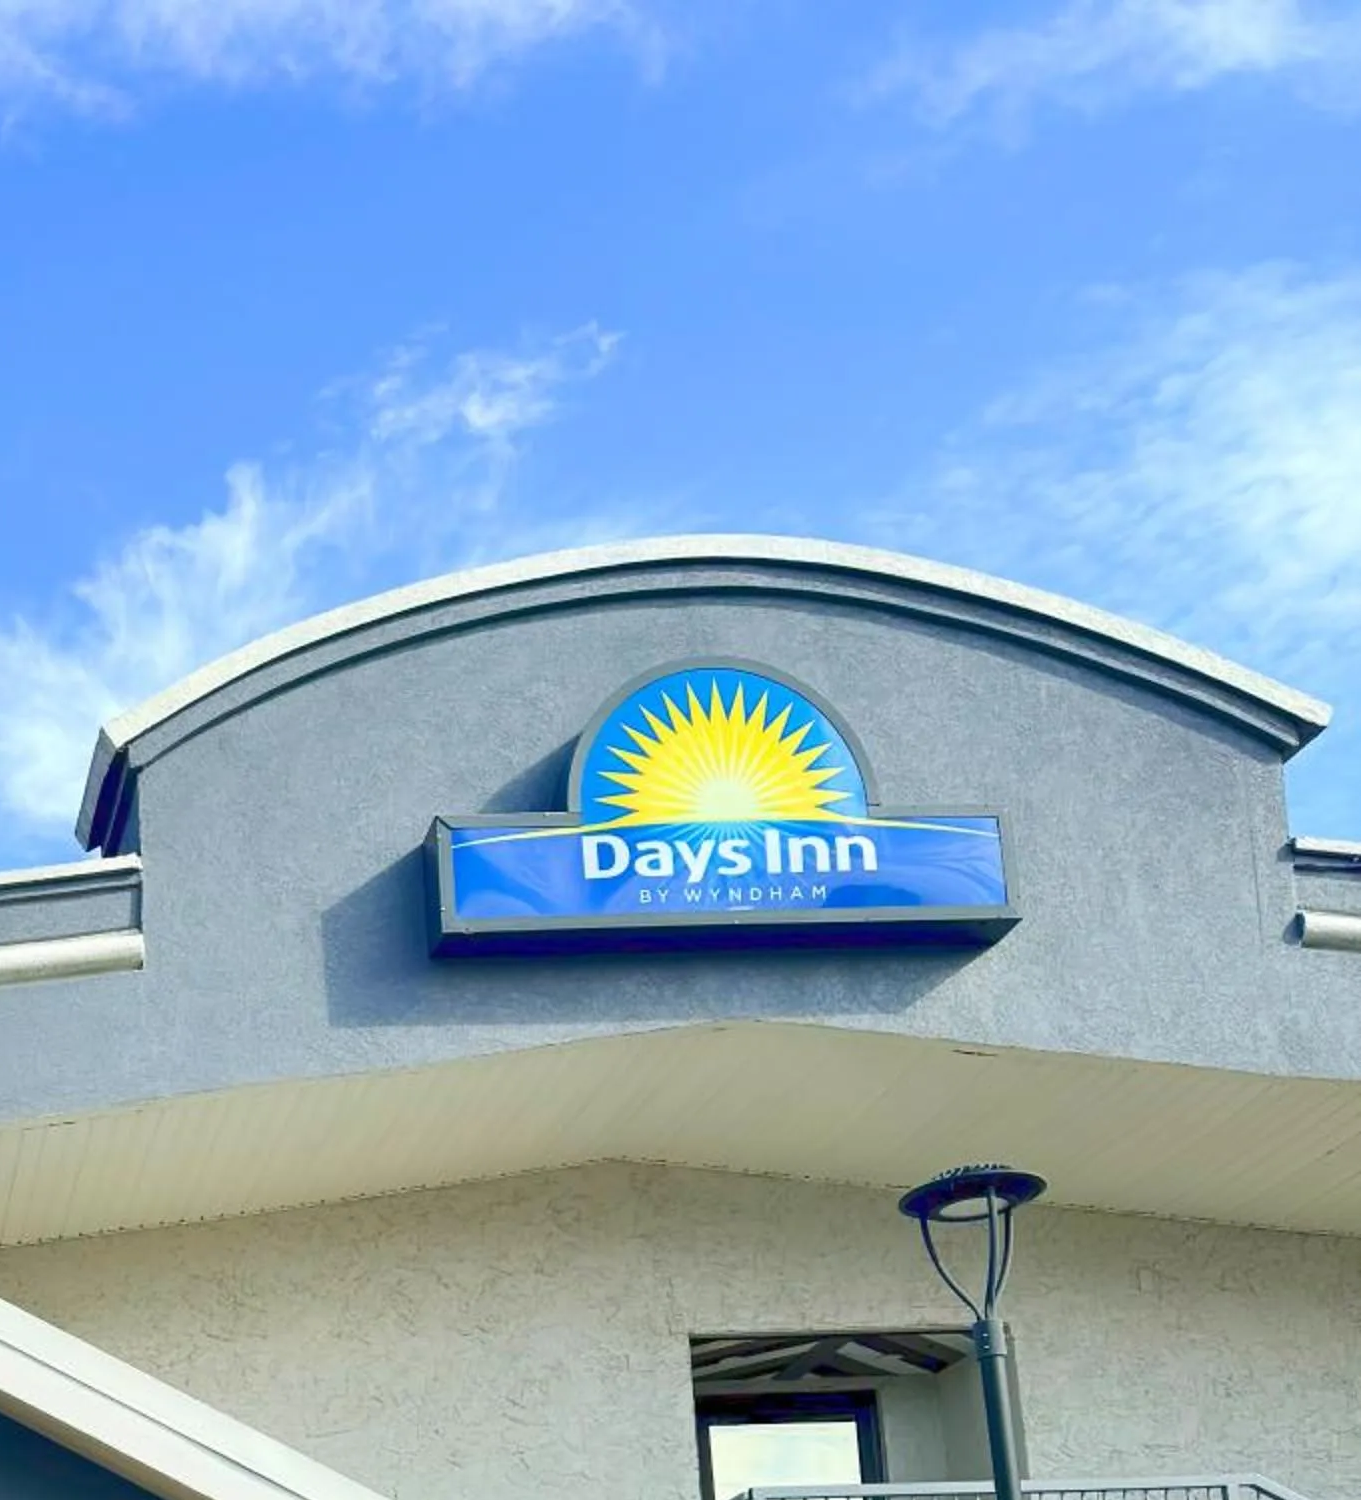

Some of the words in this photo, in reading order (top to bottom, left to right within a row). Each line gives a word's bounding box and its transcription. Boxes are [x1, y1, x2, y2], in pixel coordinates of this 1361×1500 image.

[582, 834, 752, 883] Days
[764, 828, 879, 875] Inn
[640, 888, 668, 904] BY
[684, 885, 827, 903] WYNDHAM
